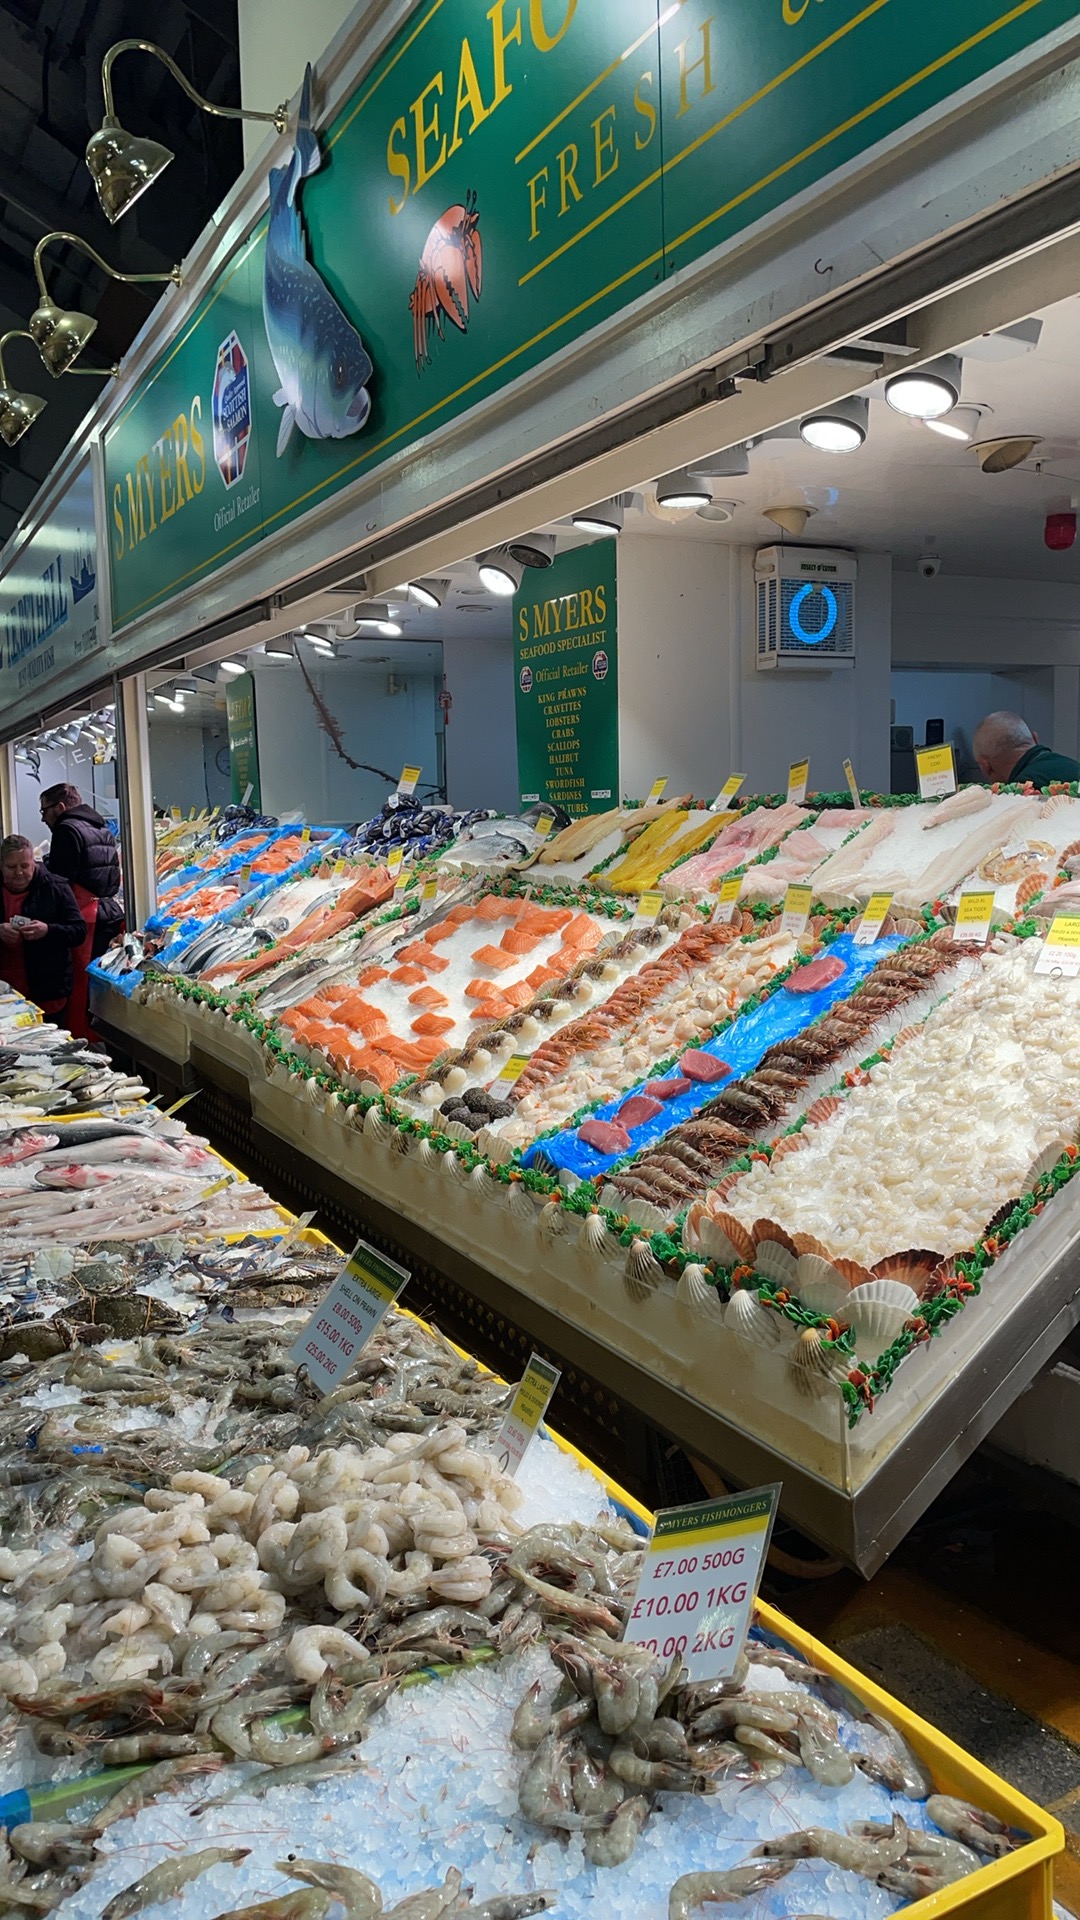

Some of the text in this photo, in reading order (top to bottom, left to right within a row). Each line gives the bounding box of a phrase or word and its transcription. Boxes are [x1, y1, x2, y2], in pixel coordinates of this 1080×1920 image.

[527, 17, 716, 242] FRESH
[223, 387, 247, 421] SCOTTISH
[226, 403, 247, 432] SALMON
[125, 395, 205, 551] MYERS
[213, 485, 260, 532] Official Retailer
[519, 584, 607, 642] S MYERS
[520, 630, 607, 660] SEAFOOD SPECIALIST
[535, 666, 560, 683] Official
[562, 661, 589, 678] Retailer
[537, 686, 587, 704] KING PRAWNS
[545, 714, 580, 728] LOBSTERS
[551, 728, 575, 739] CRABS
[547, 740, 580, 752] SCALLOPS
[549, 752, 579, 764] HALIBUT
[545, 778, 585, 790] SWORDFISH
[555, 767, 574, 776] TUNA
[549, 790, 582, 801] SARDINES
[567, 803, 589, 813] TUBES
[339, 1285, 378, 1318] SHELL ON PRAWN
[352, 1274, 383, 1301] EXTRA LARGE
[332, 1302, 363, 1335] £8.00 500g
[316, 1319, 355, 1356] £15.00 1KG
[305, 1342, 338, 1375] £25.00 2KG
[667, 1516, 698, 1530] MYERS
[701, 1500, 767, 1524] FISHMONGERS
[653, 1547, 745, 1579] £7.00 500G
[630, 1581, 748, 1619] £10.00 1KG
[691, 1627, 735, 1654] 2KG
